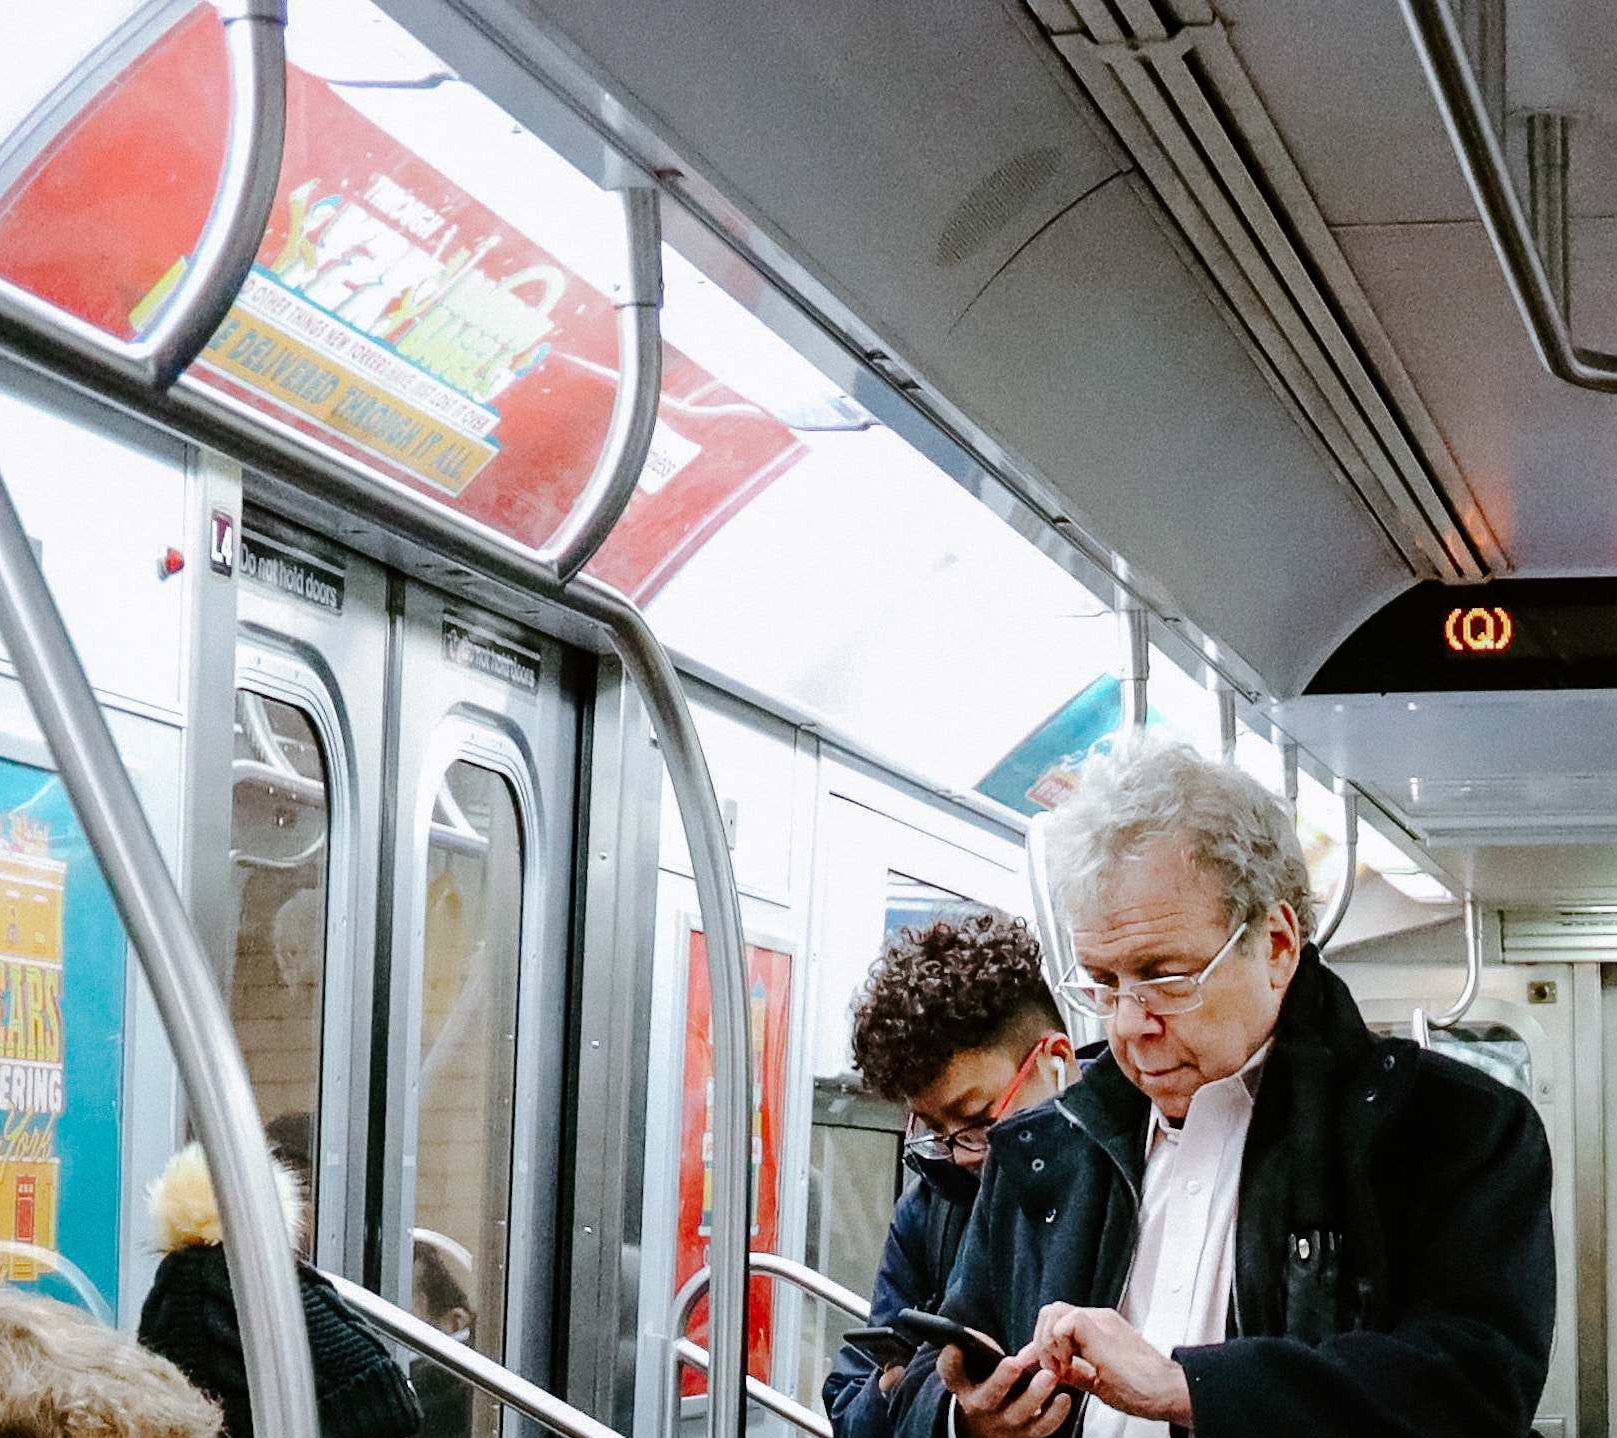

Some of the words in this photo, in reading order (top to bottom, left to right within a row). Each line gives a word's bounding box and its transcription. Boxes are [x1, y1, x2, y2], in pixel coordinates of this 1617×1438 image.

[226, 327, 341, 405] DELIVERED
[240, 543, 256, 575] Do
[258, 551, 280, 588] not
[282, 557, 305, 597] hold
[305, 566, 338, 608] doors
